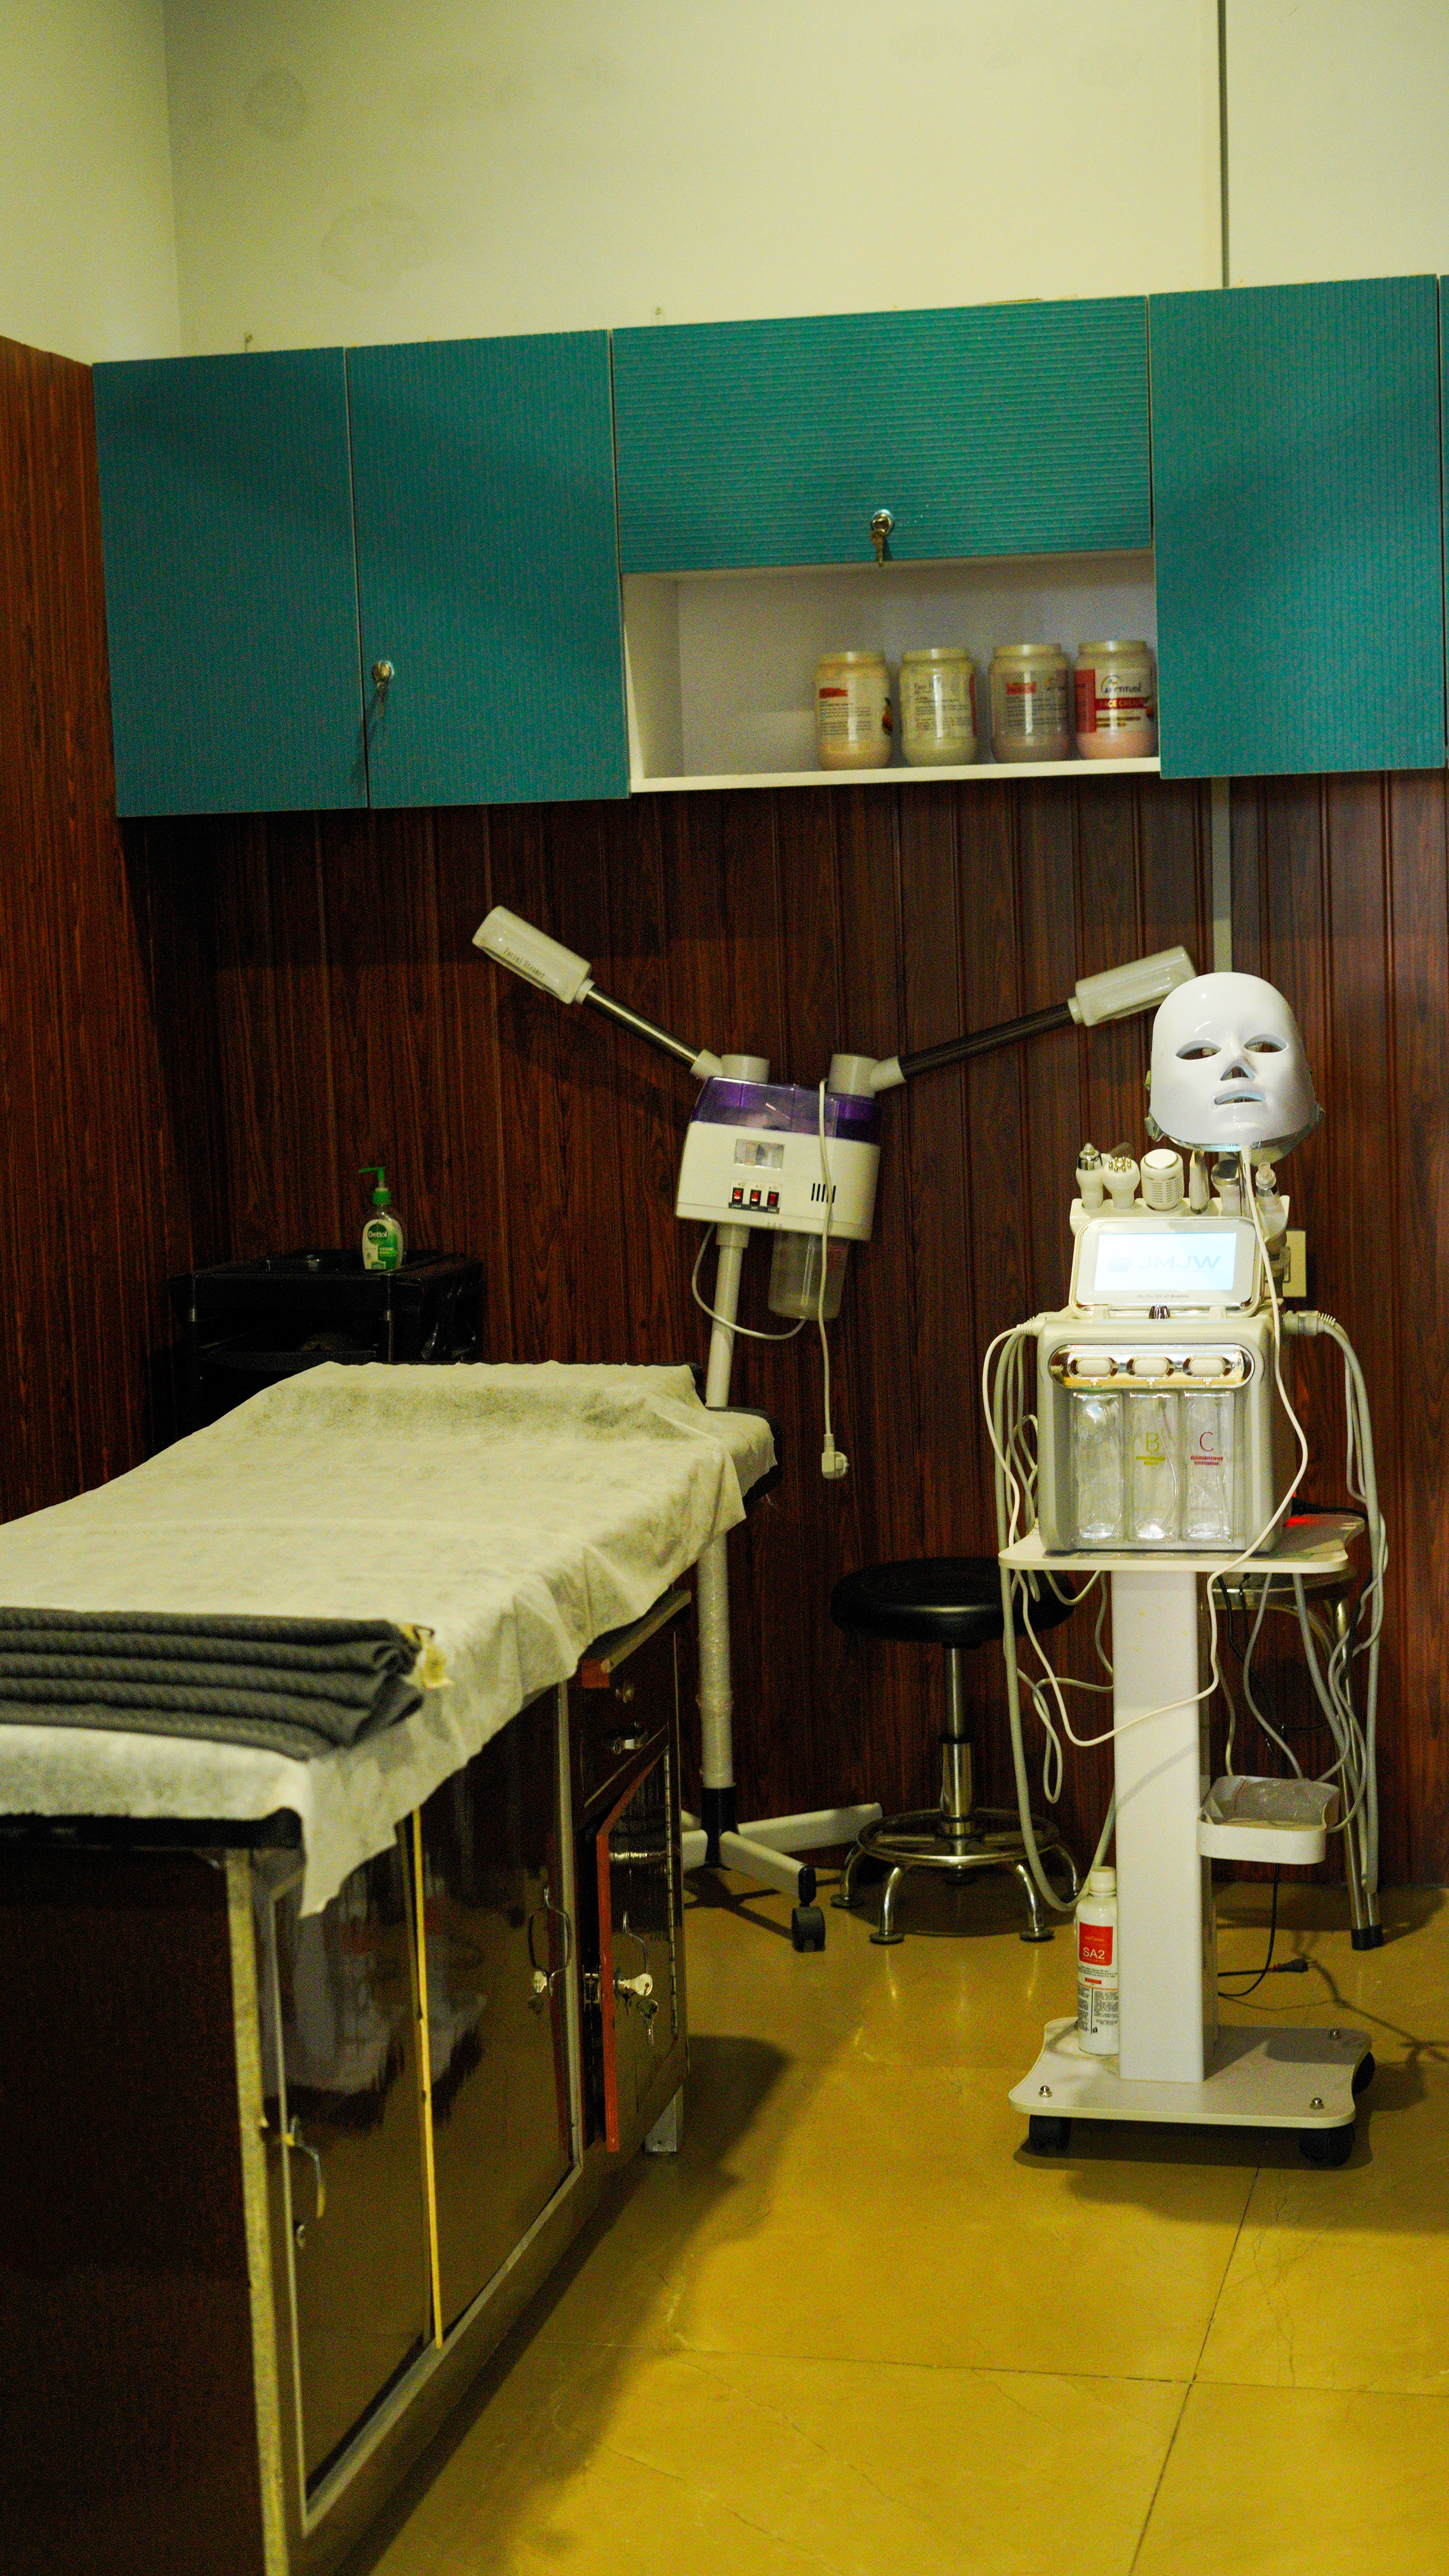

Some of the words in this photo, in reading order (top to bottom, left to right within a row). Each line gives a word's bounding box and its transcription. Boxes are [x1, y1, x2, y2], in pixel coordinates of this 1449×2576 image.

[1138, 1256, 1221, 1269] JMJW
[1146, 1432, 1159, 1452] B
[1200, 1432, 1214, 1451] C
[1083, 1947, 1105, 1960] SA2
